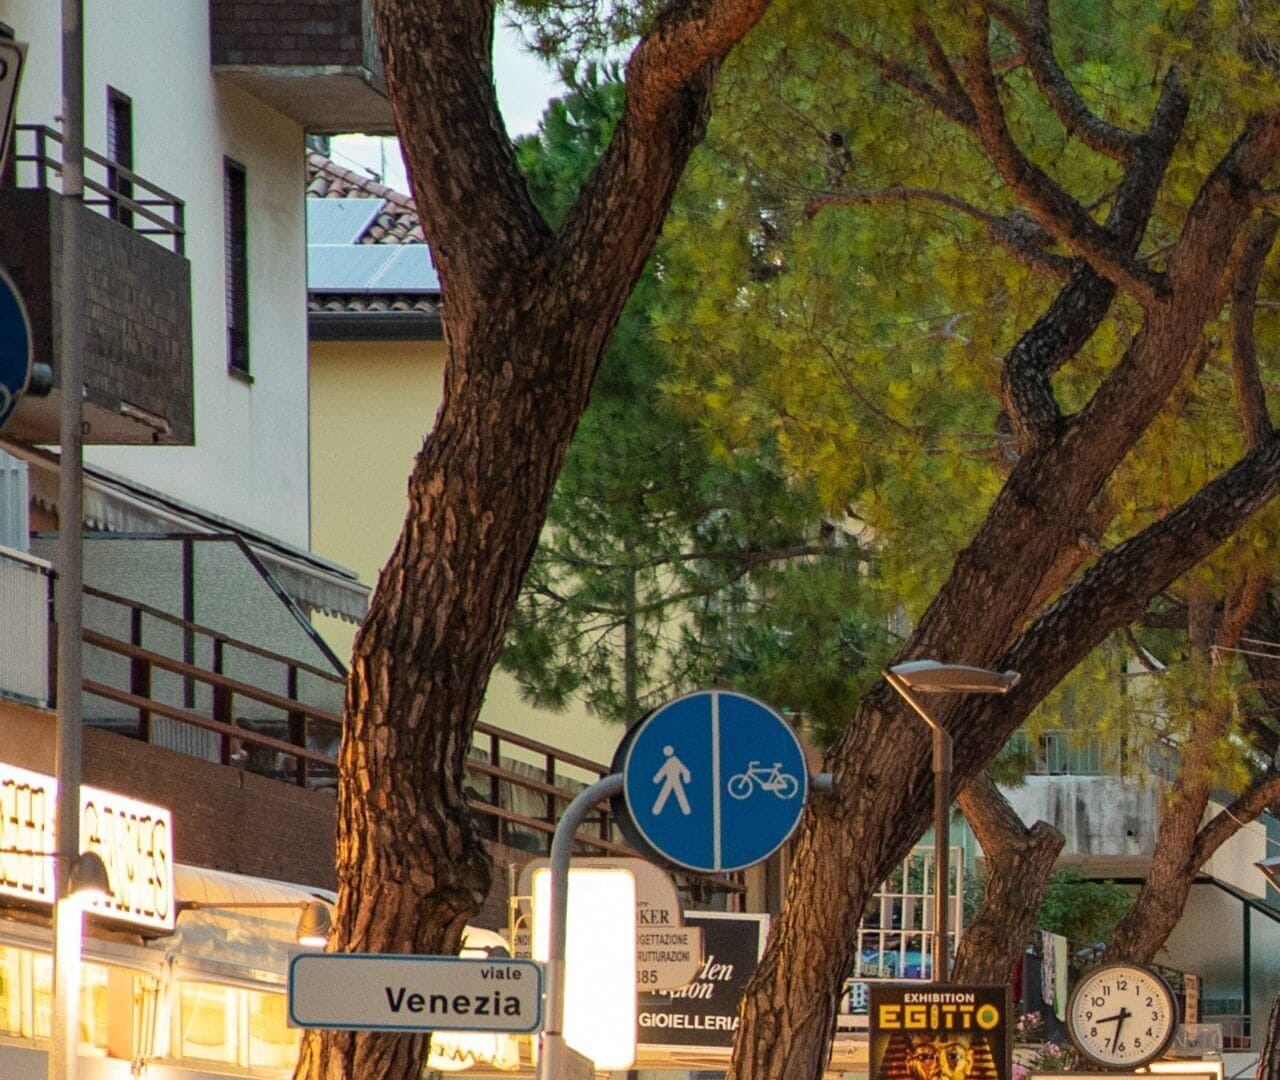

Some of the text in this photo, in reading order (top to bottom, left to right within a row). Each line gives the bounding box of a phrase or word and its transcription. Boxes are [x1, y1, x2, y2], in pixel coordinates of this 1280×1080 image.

[480, 967, 522, 980] viale
[1117, 981, 1127, 990] 12
[1103, 986, 1110, 995] 11
[1136, 986, 1140, 995] 1
[385, 987, 521, 1016] Venezia
[904, 993, 975, 1003] EXHIBITION
[1091, 997, 1105, 1007] 10
[1146, 997, 1153, 1006] 2
[879, 1004, 999, 1030] EGITTO
[1085, 1012, 1093, 1021] 9
[1152, 1012, 1158, 1021] 3
[1090, 1027, 1098, 1037] 8
[1145, 1028, 1152, 1037] 4
[1105, 1038, 1111, 1047] 7
[1134, 1039, 1141, 1048] 5
[1119, 1043, 1125, 1052] 6
